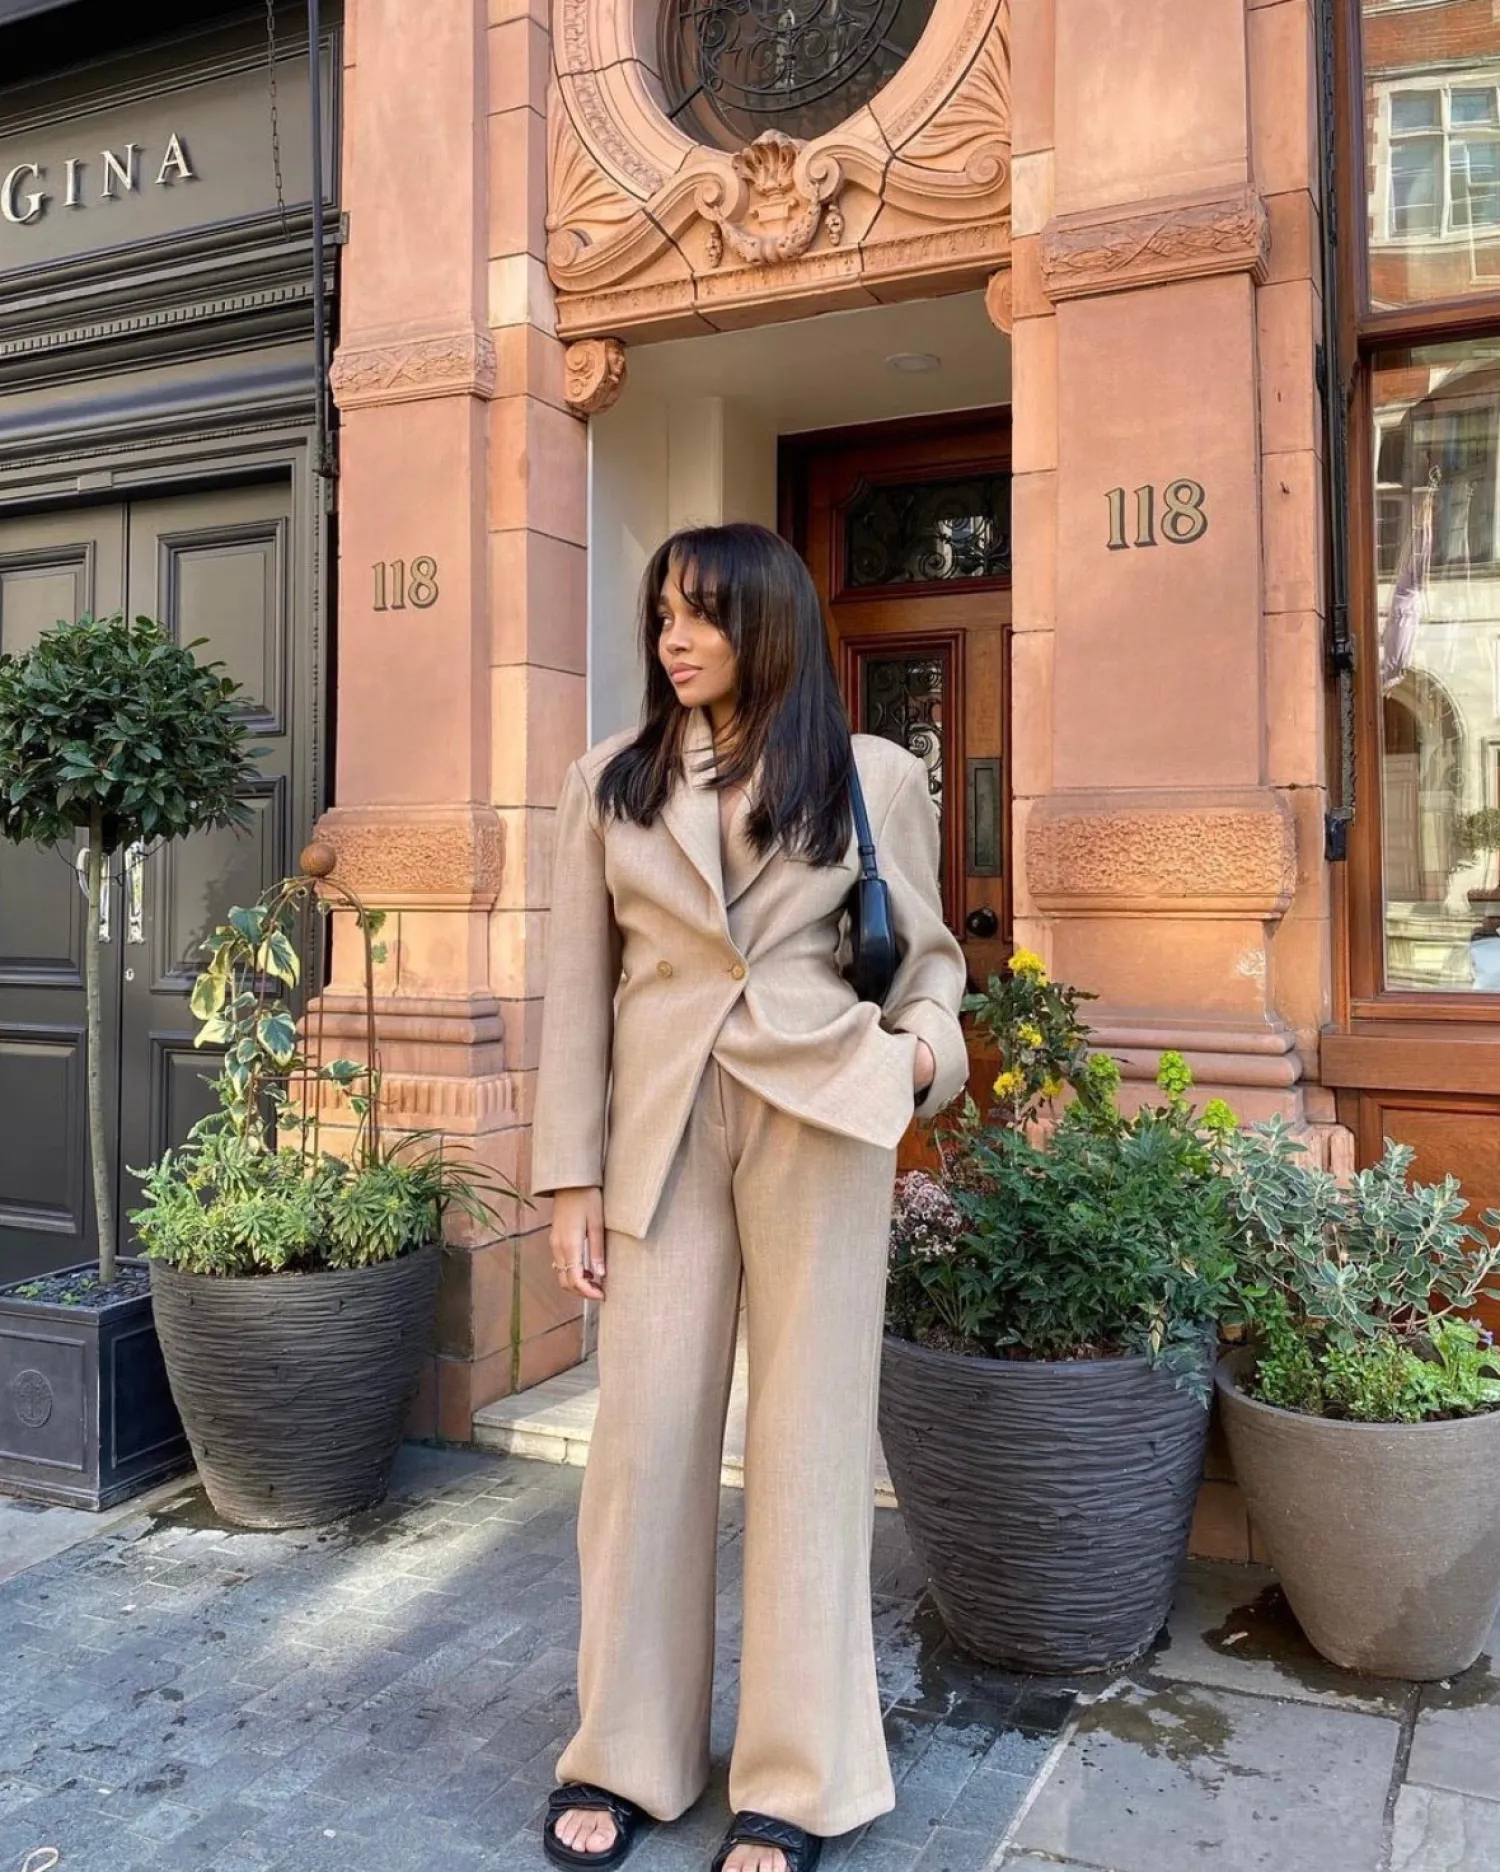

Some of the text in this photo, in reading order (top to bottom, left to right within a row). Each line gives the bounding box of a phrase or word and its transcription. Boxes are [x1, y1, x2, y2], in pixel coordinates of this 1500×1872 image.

[1, 132, 193, 224] GINA
[1104, 478, 1208, 550] 118
[371, 555, 439, 612] 118
